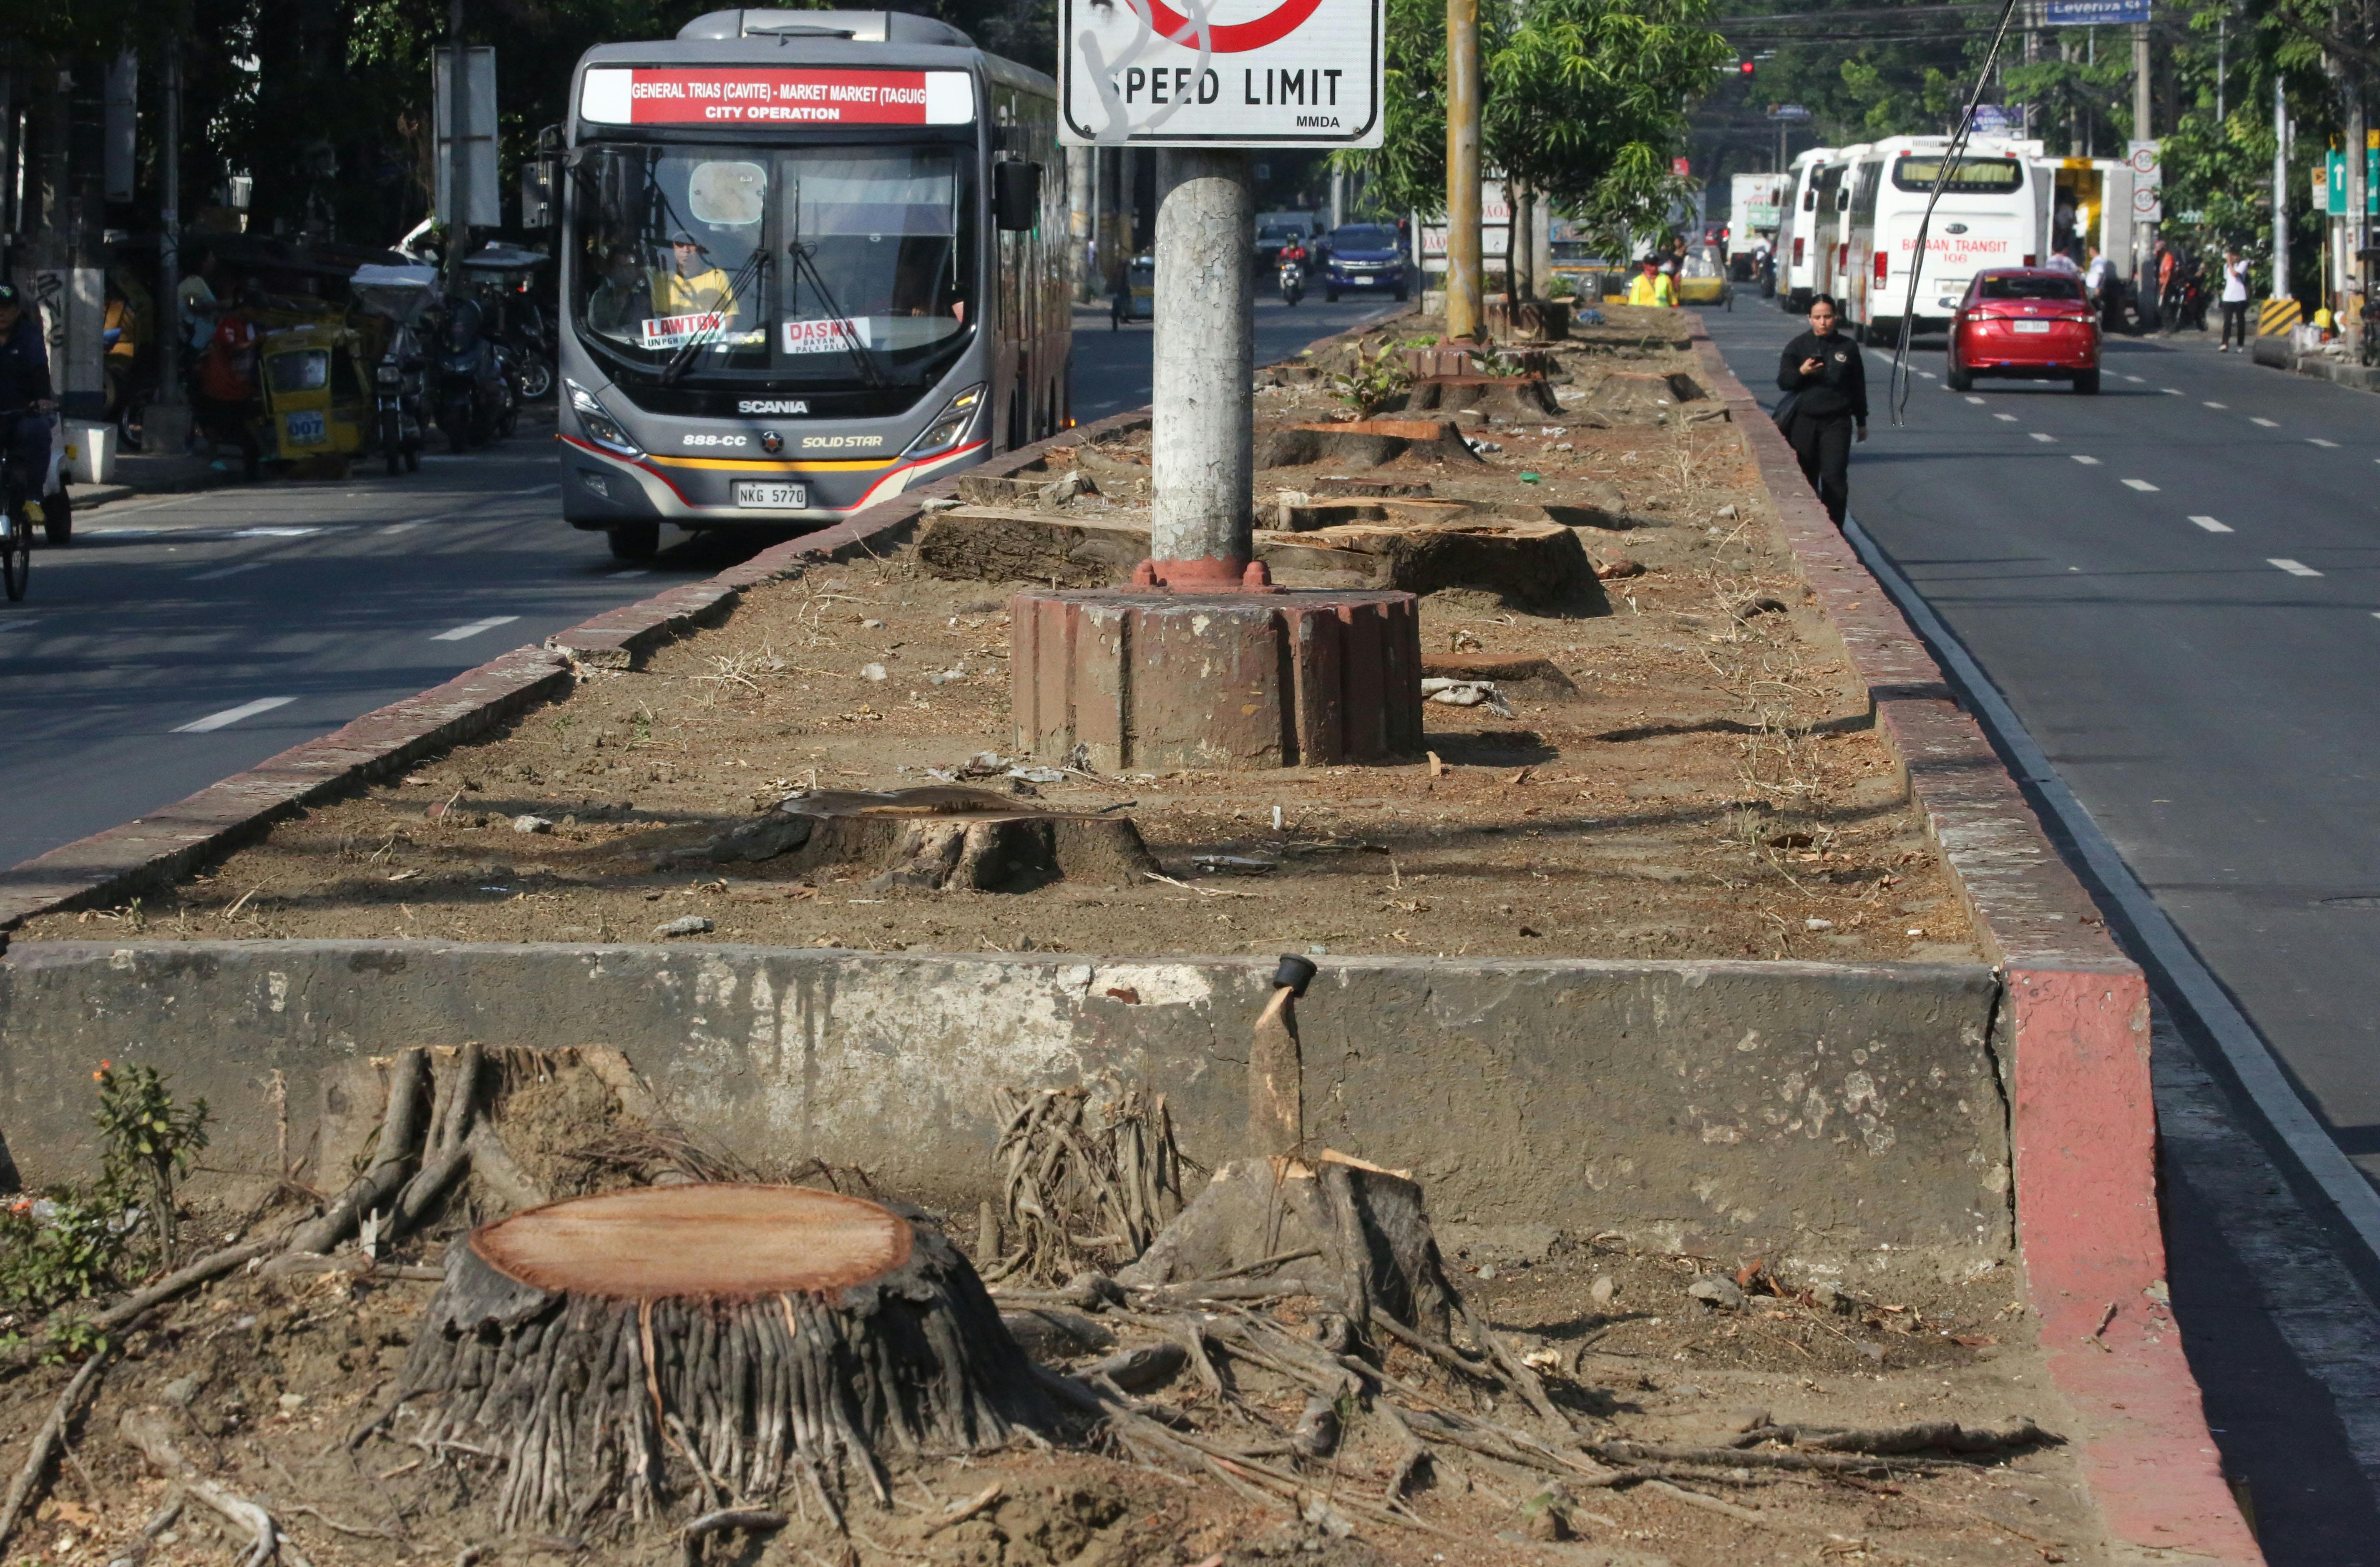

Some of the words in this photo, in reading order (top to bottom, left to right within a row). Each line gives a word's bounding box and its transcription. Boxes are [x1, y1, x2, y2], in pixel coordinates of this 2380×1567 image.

[632, 83, 685, 98] GENERAL
[688, 83, 721, 98] TRIAS
[724, 83, 770, 102] (CAVITE)
[780, 84, 828, 100] MARKET
[830, 86, 877, 102] MARKET
[880, 87, 926, 106] (TAGUIG
[1245, 69, 1342, 106] LIMIT
[705, 106, 743, 118] CITY
[747, 107, 840, 120] OPERATION
[1296, 116, 1341, 128] MMDA
[1902, 239, 1949, 251] BAAAN
[1956, 239, 2008, 253] TRANSIT
[1944, 254, 1967, 263] 106
[648, 313, 720, 337] LAWTON
[790, 320, 856, 340] DASMA
[648, 338, 660, 347] UN
[662, 337, 678, 345] PGH
[803, 337, 835, 345] BAYAN
[738, 401, 808, 413] SCANIA
[683, 435, 747, 446] 888-CC
[803, 436, 844, 447] SOLID
[845, 436, 882, 446] STAR
[741, 489, 763, 502] NKG
[773, 490, 803, 503] 5770
